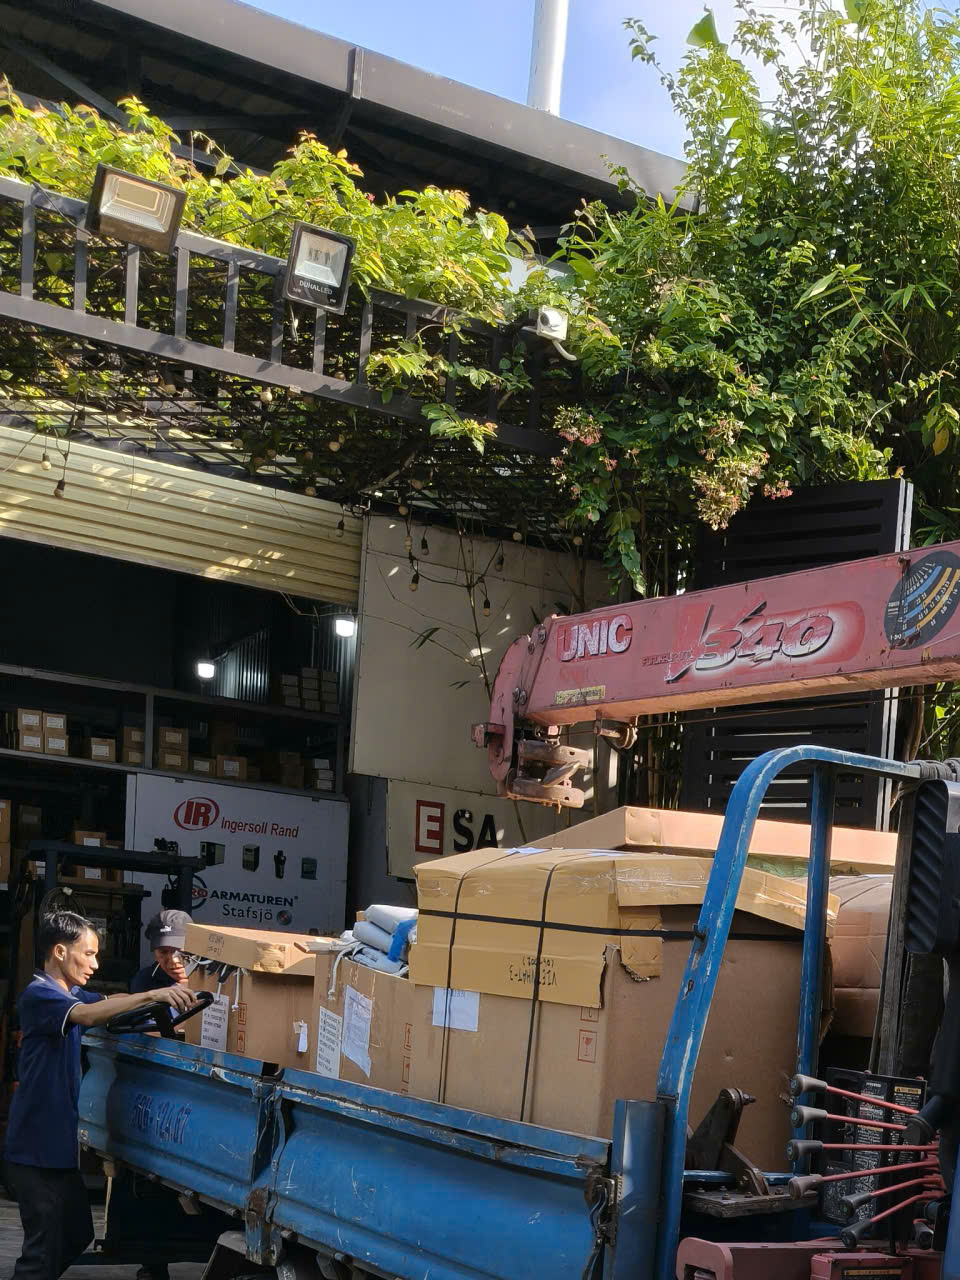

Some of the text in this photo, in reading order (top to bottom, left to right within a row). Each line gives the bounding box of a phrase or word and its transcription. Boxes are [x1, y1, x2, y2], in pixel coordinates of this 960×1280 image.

[558, 613, 633, 662] UNIC
[183, 800, 212, 828] IR
[221, 816, 299, 839] Ingersoll Rand
[222, 904, 273, 922] Stafsjö
